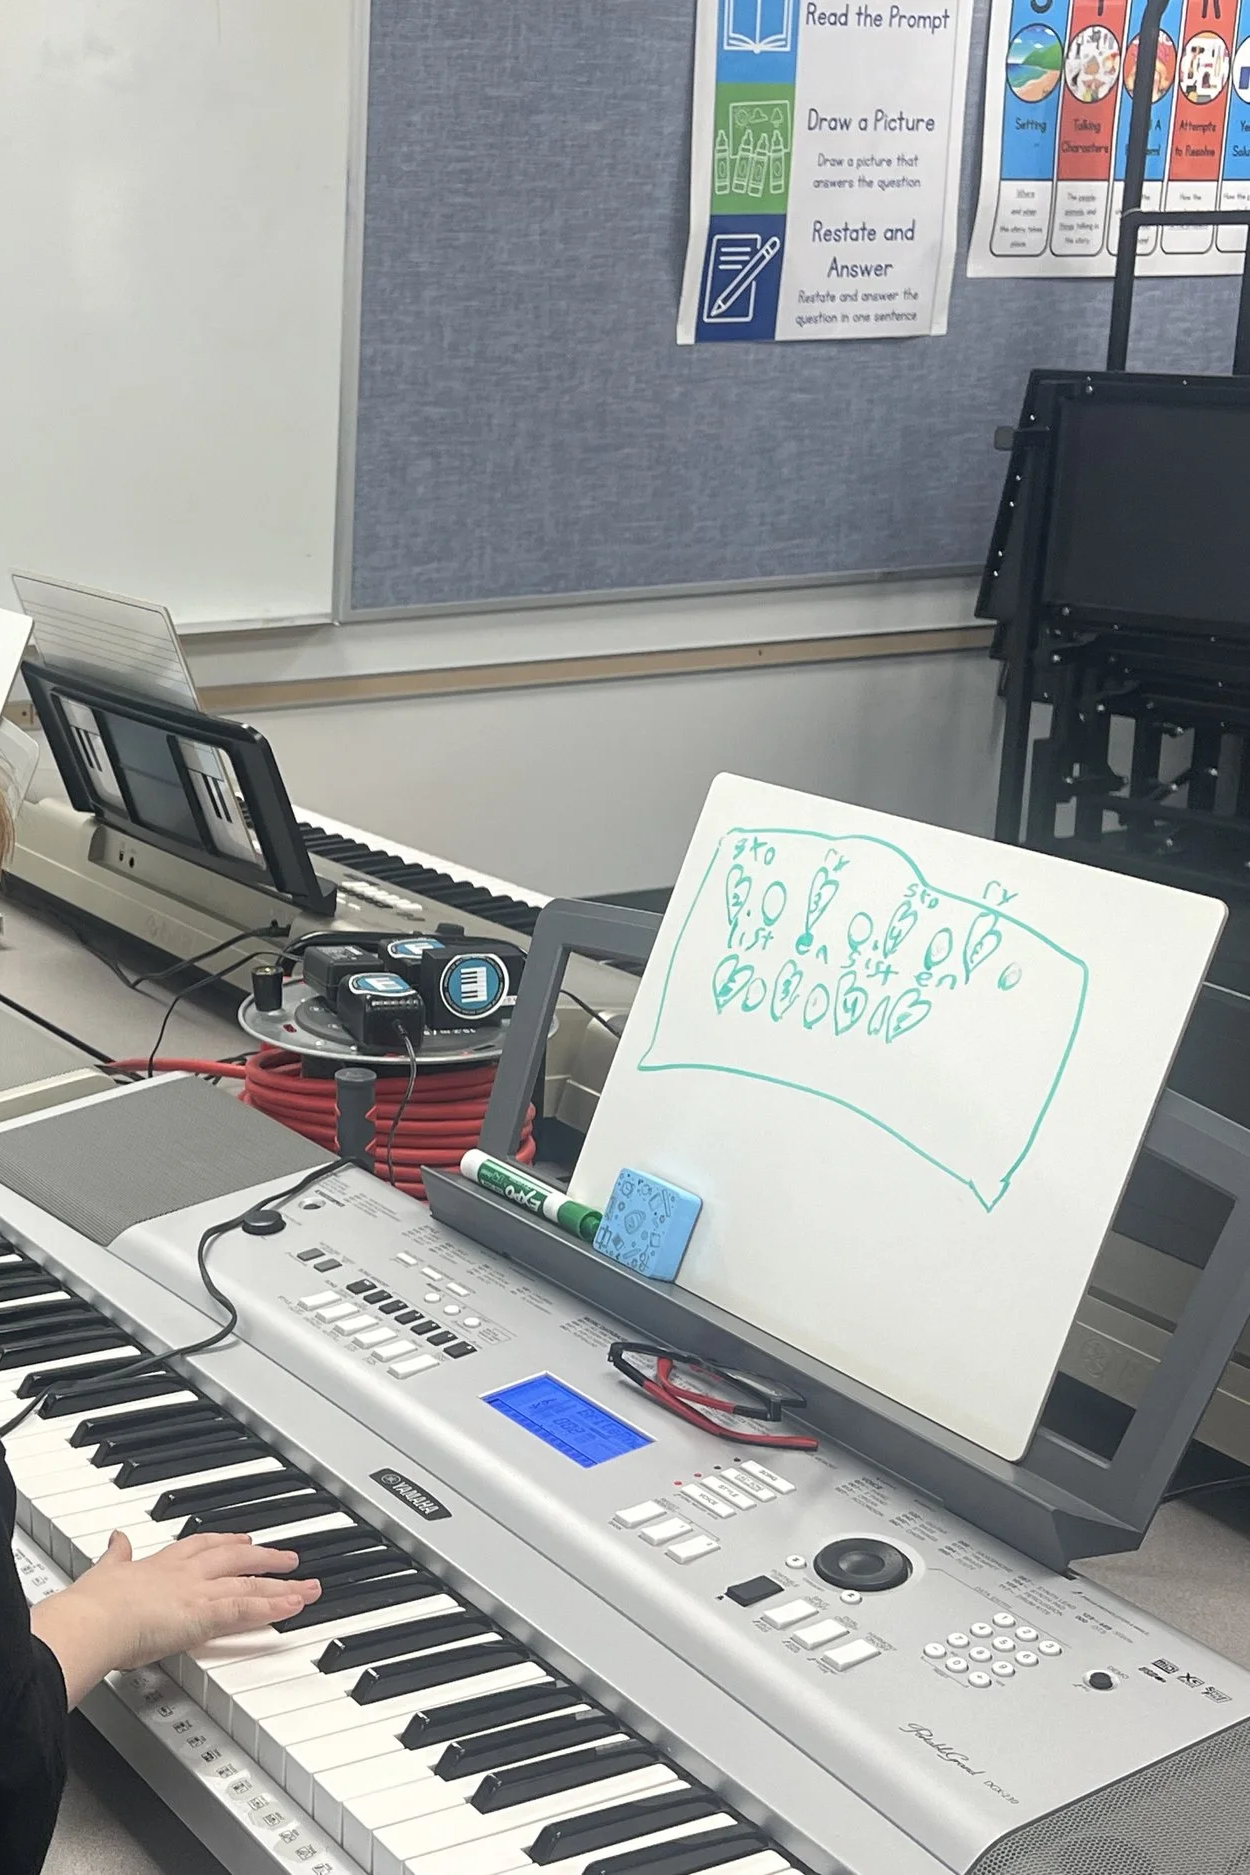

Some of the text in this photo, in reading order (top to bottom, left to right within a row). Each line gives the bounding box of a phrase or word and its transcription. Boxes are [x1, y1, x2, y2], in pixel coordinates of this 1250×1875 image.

[806, 2, 950, 34] Read the Prompt
[807, 108, 936, 132] Draw a Picture
[1015, 117, 1047, 133] Setting
[1073, 118, 1102, 134] Talking
[1179, 120, 1217, 134] Attempts
[1061, 140, 1109, 154] Characters
[1175, 145, 1215, 157] to Resolve
[817, 153, 919, 169] Draw a picture that
[813, 174, 921, 191] answers the question
[812, 218, 915, 242] Restate and
[827, 255, 894, 278] Answer
[798, 287, 919, 304] Restate and answer the
[795, 309, 918, 328] question in one sentence
[505, 1185, 541, 1212] EXPO
[392, 1482, 439, 1515] YAMAHA
